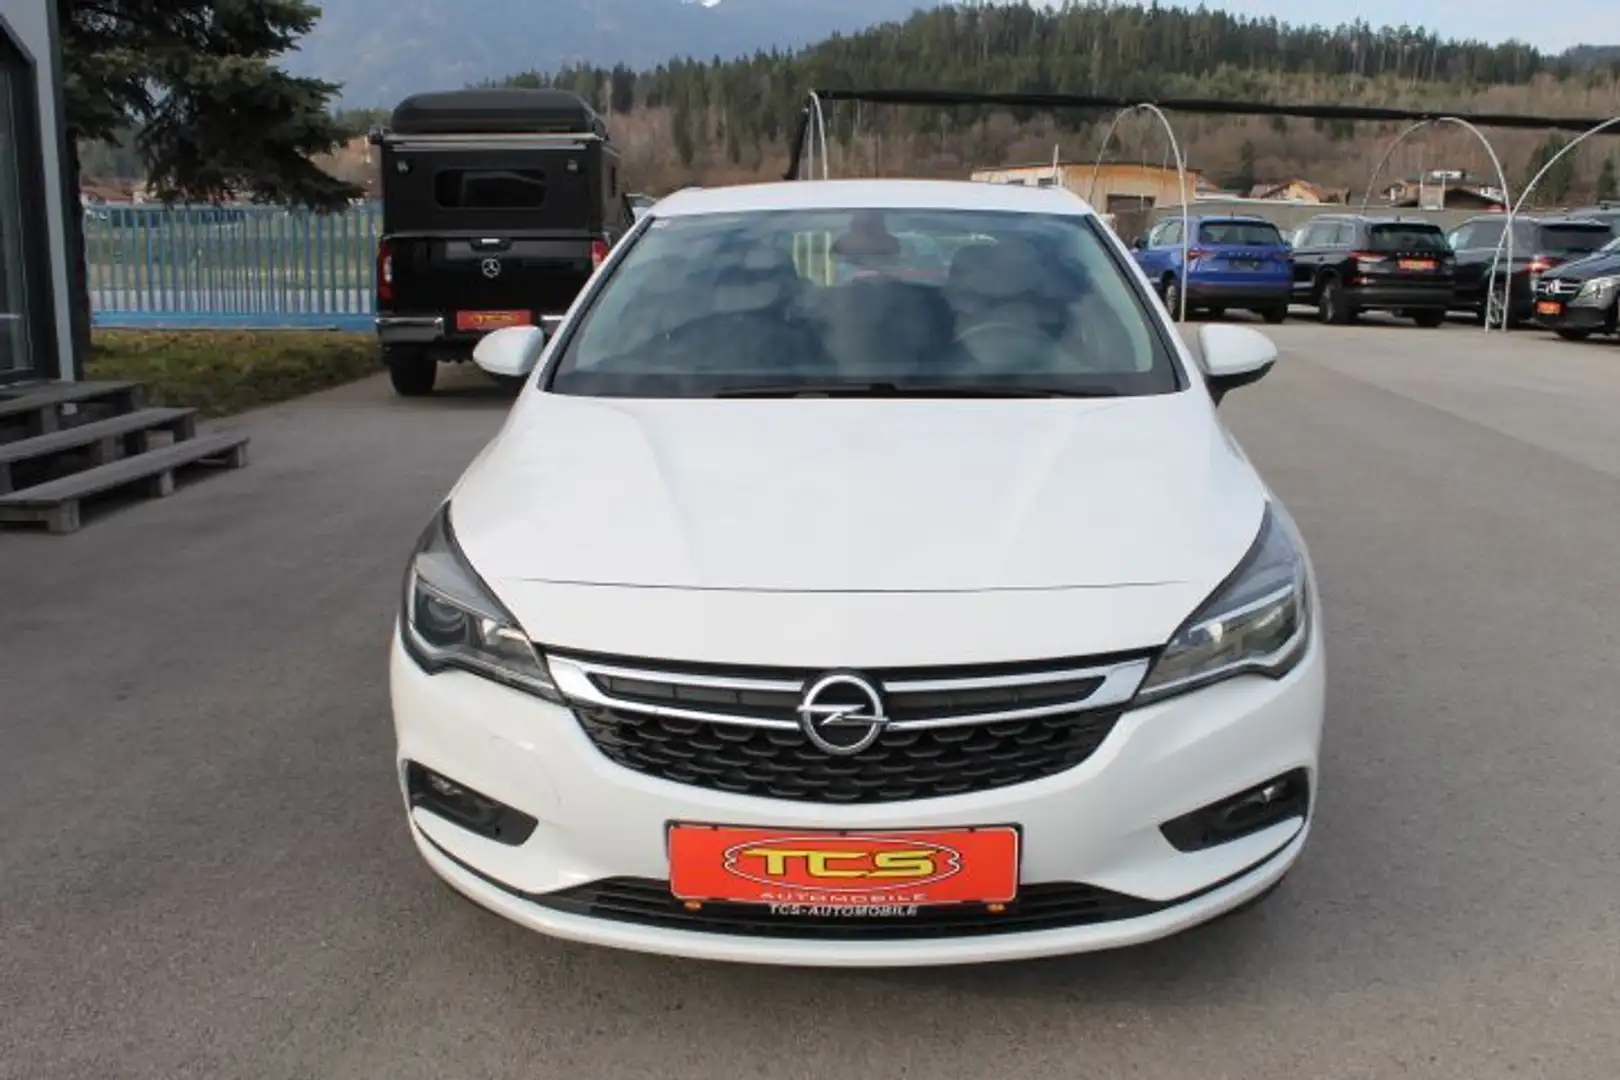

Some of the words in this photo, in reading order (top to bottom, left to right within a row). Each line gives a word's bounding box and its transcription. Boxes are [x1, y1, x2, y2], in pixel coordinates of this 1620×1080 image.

[743, 848, 937, 877] TCS
[760, 893, 927, 903] AUTOMOBILE
[769, 904, 918, 917] TCS-AUTOMOBILE
